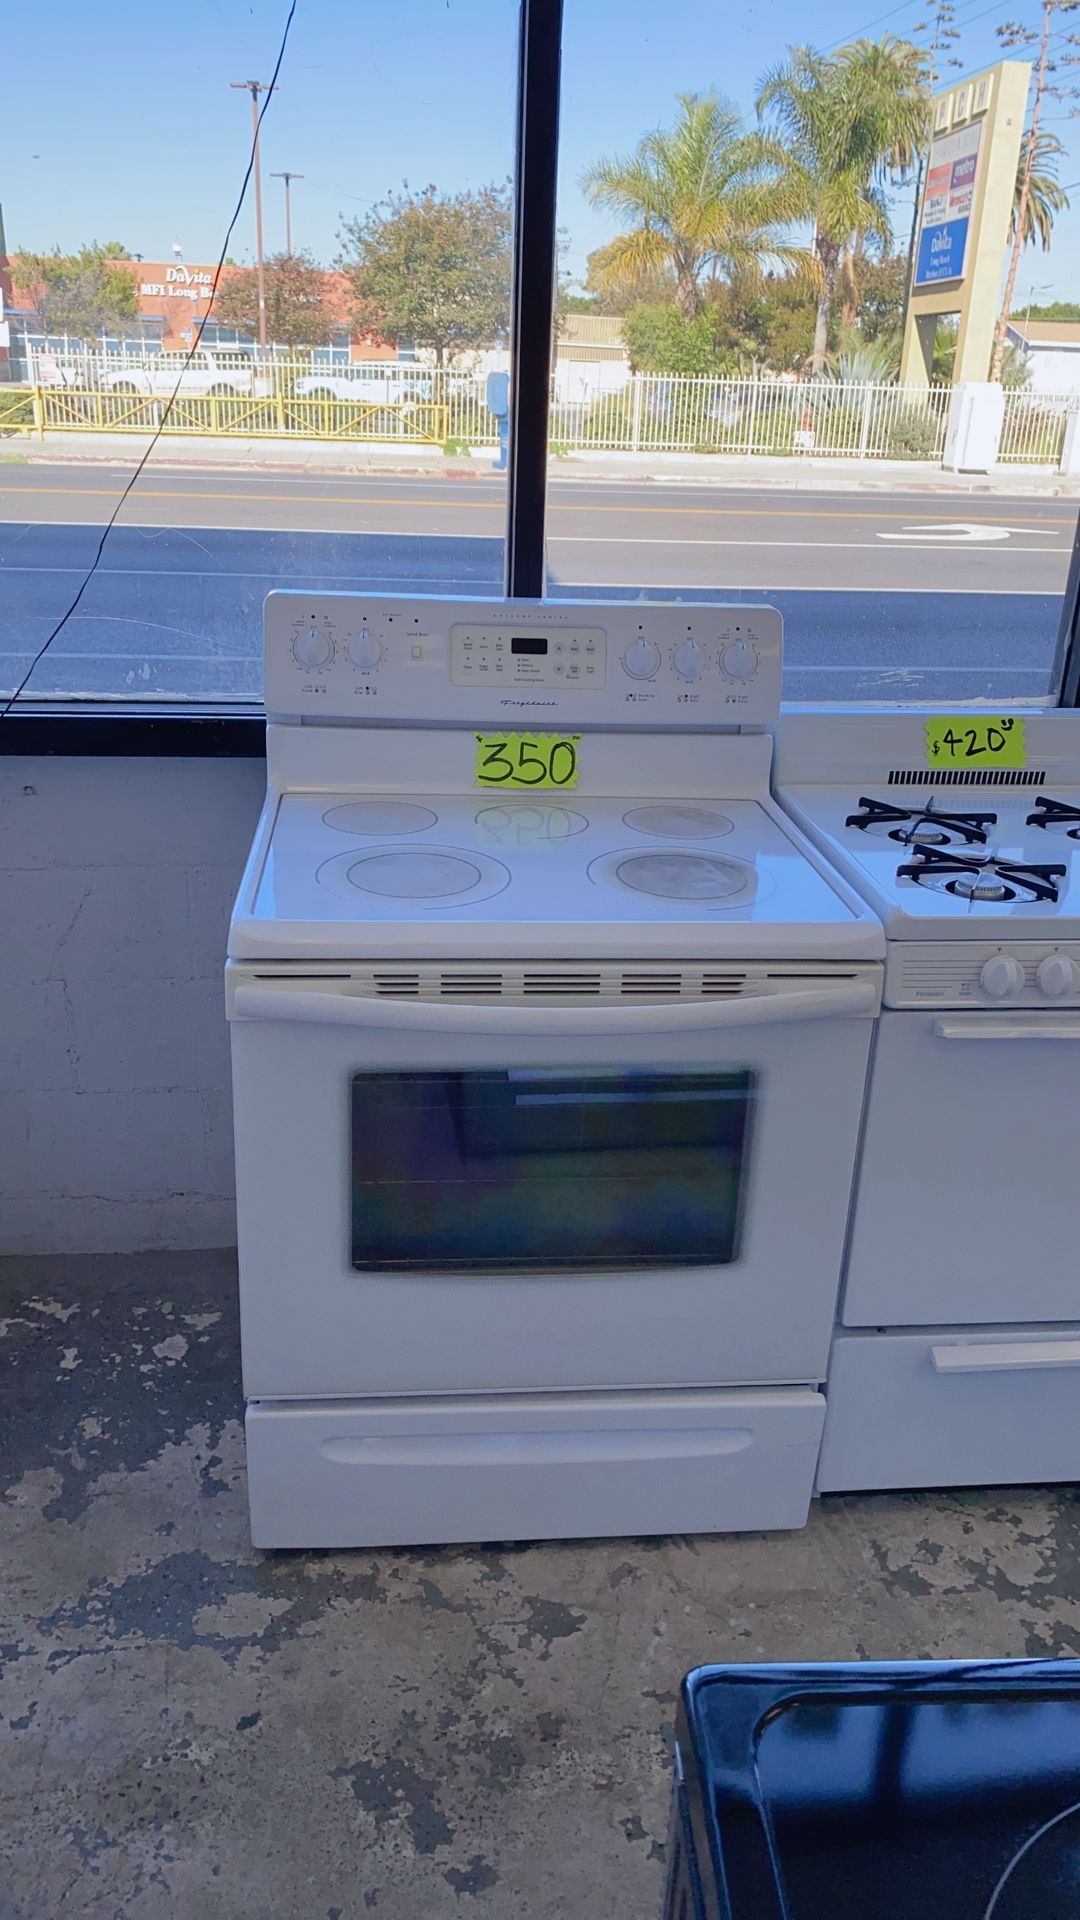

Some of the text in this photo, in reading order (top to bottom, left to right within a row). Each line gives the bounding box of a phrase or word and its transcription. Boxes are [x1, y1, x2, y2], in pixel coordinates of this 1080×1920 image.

[141, 284, 165, 296] MFI
[168, 286, 198, 300] Long
[499, 699, 559, 707] Frigidaire
